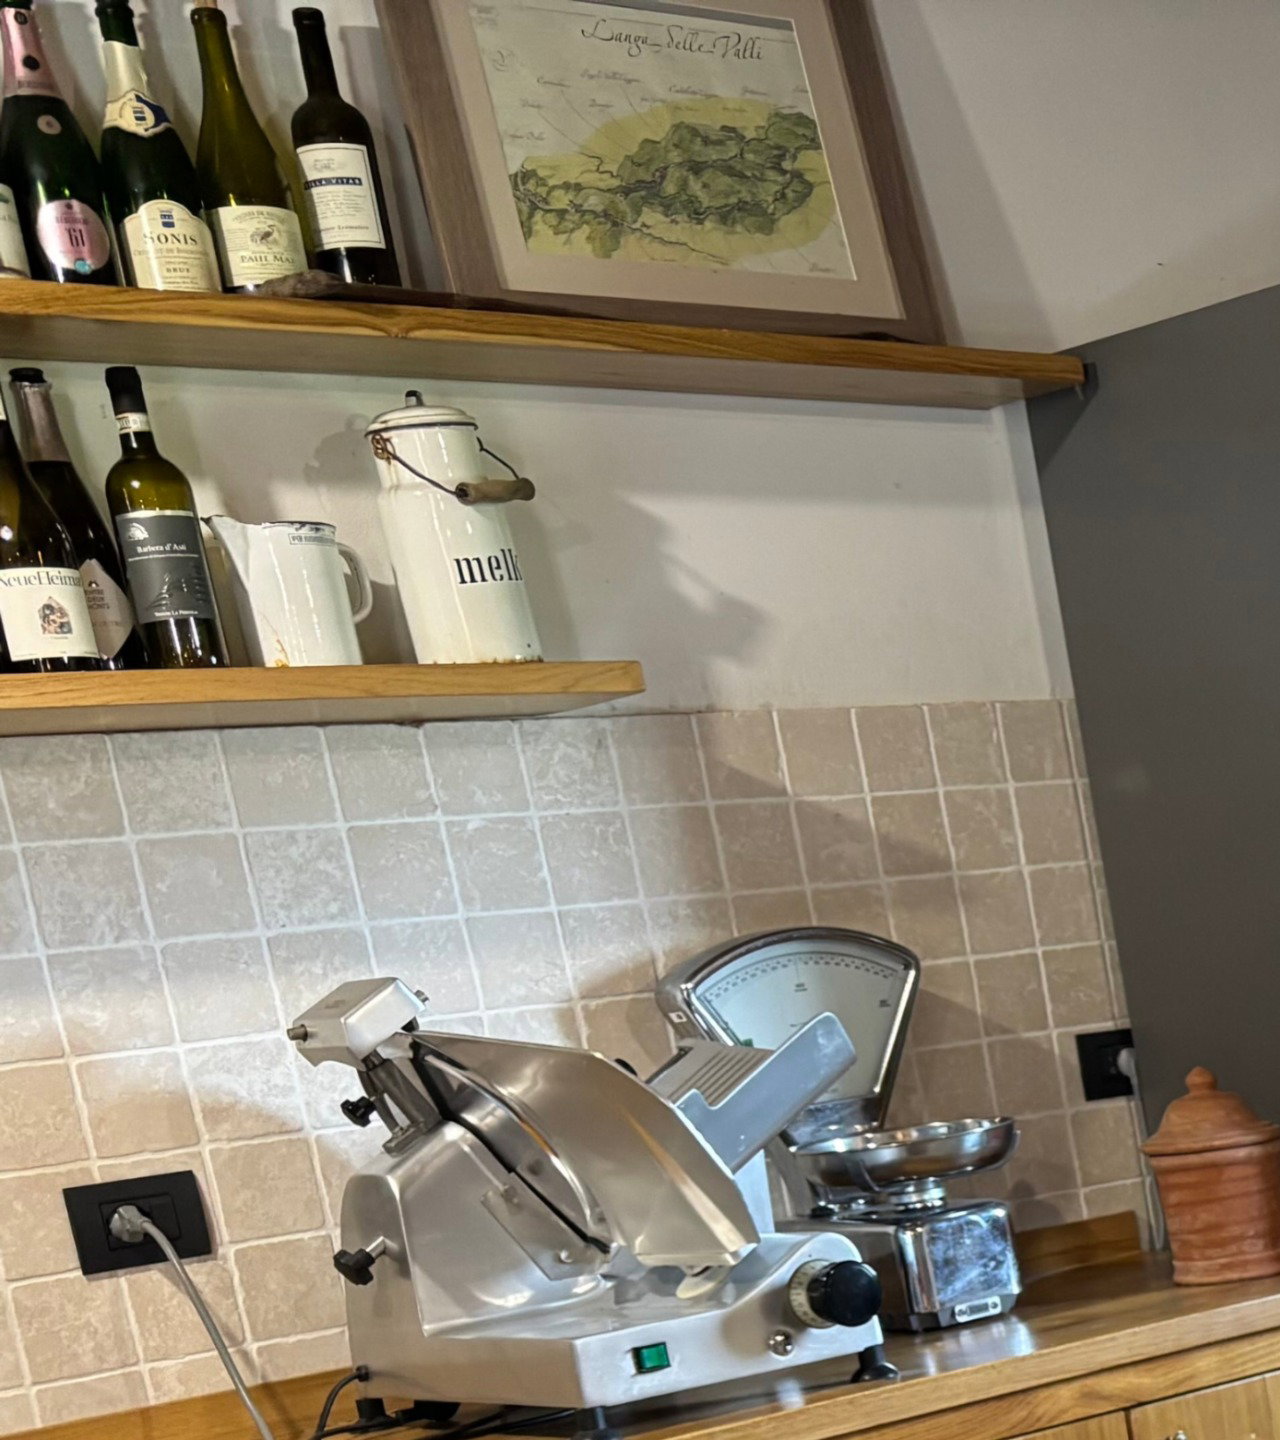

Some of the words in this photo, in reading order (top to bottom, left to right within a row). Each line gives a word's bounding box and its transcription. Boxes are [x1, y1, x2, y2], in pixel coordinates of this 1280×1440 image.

[581, 19, 661, 58] Langa
[712, 31, 764, 60] Valli
[453, 548, 523, 585] melk
